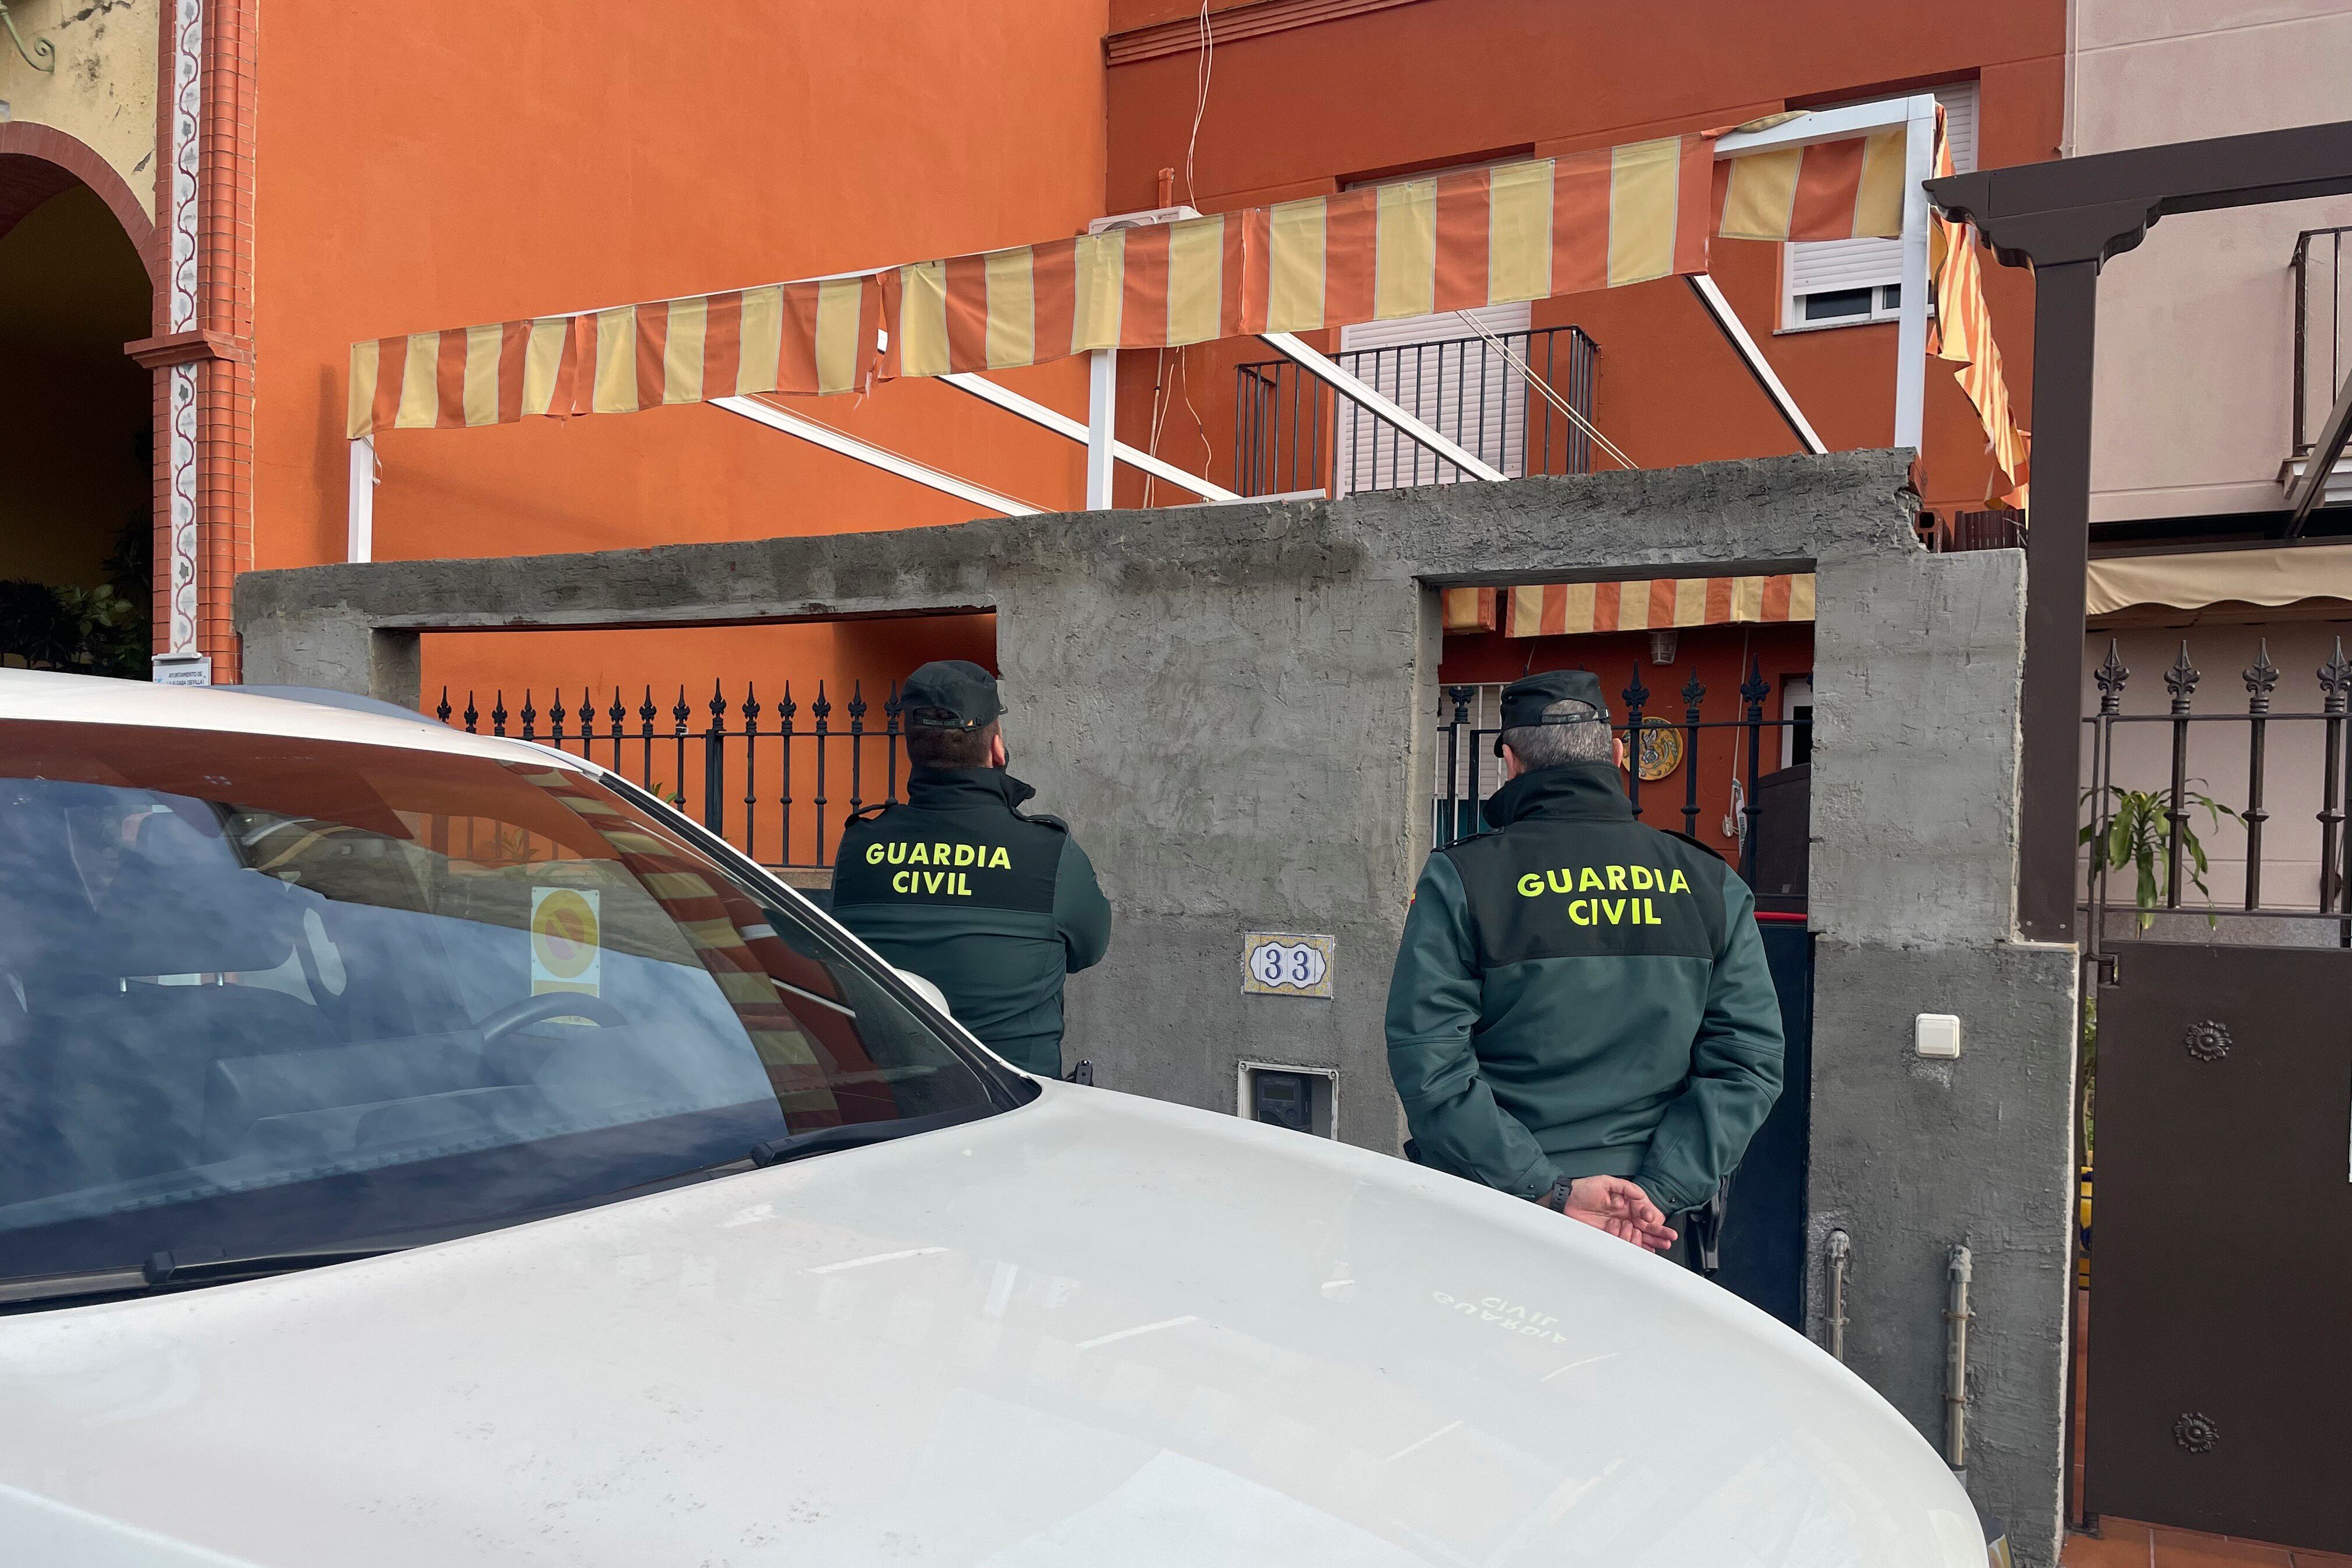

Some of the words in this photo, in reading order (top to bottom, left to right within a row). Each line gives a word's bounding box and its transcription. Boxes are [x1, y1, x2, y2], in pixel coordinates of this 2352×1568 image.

[866, 842, 1012, 870] GUARDIA
[892, 871, 972, 895] CIVIL
[1517, 865, 1691, 897] GUARDIA
[1568, 898, 1661, 926] CIVIL
[1265, 949, 1311, 981] 33
